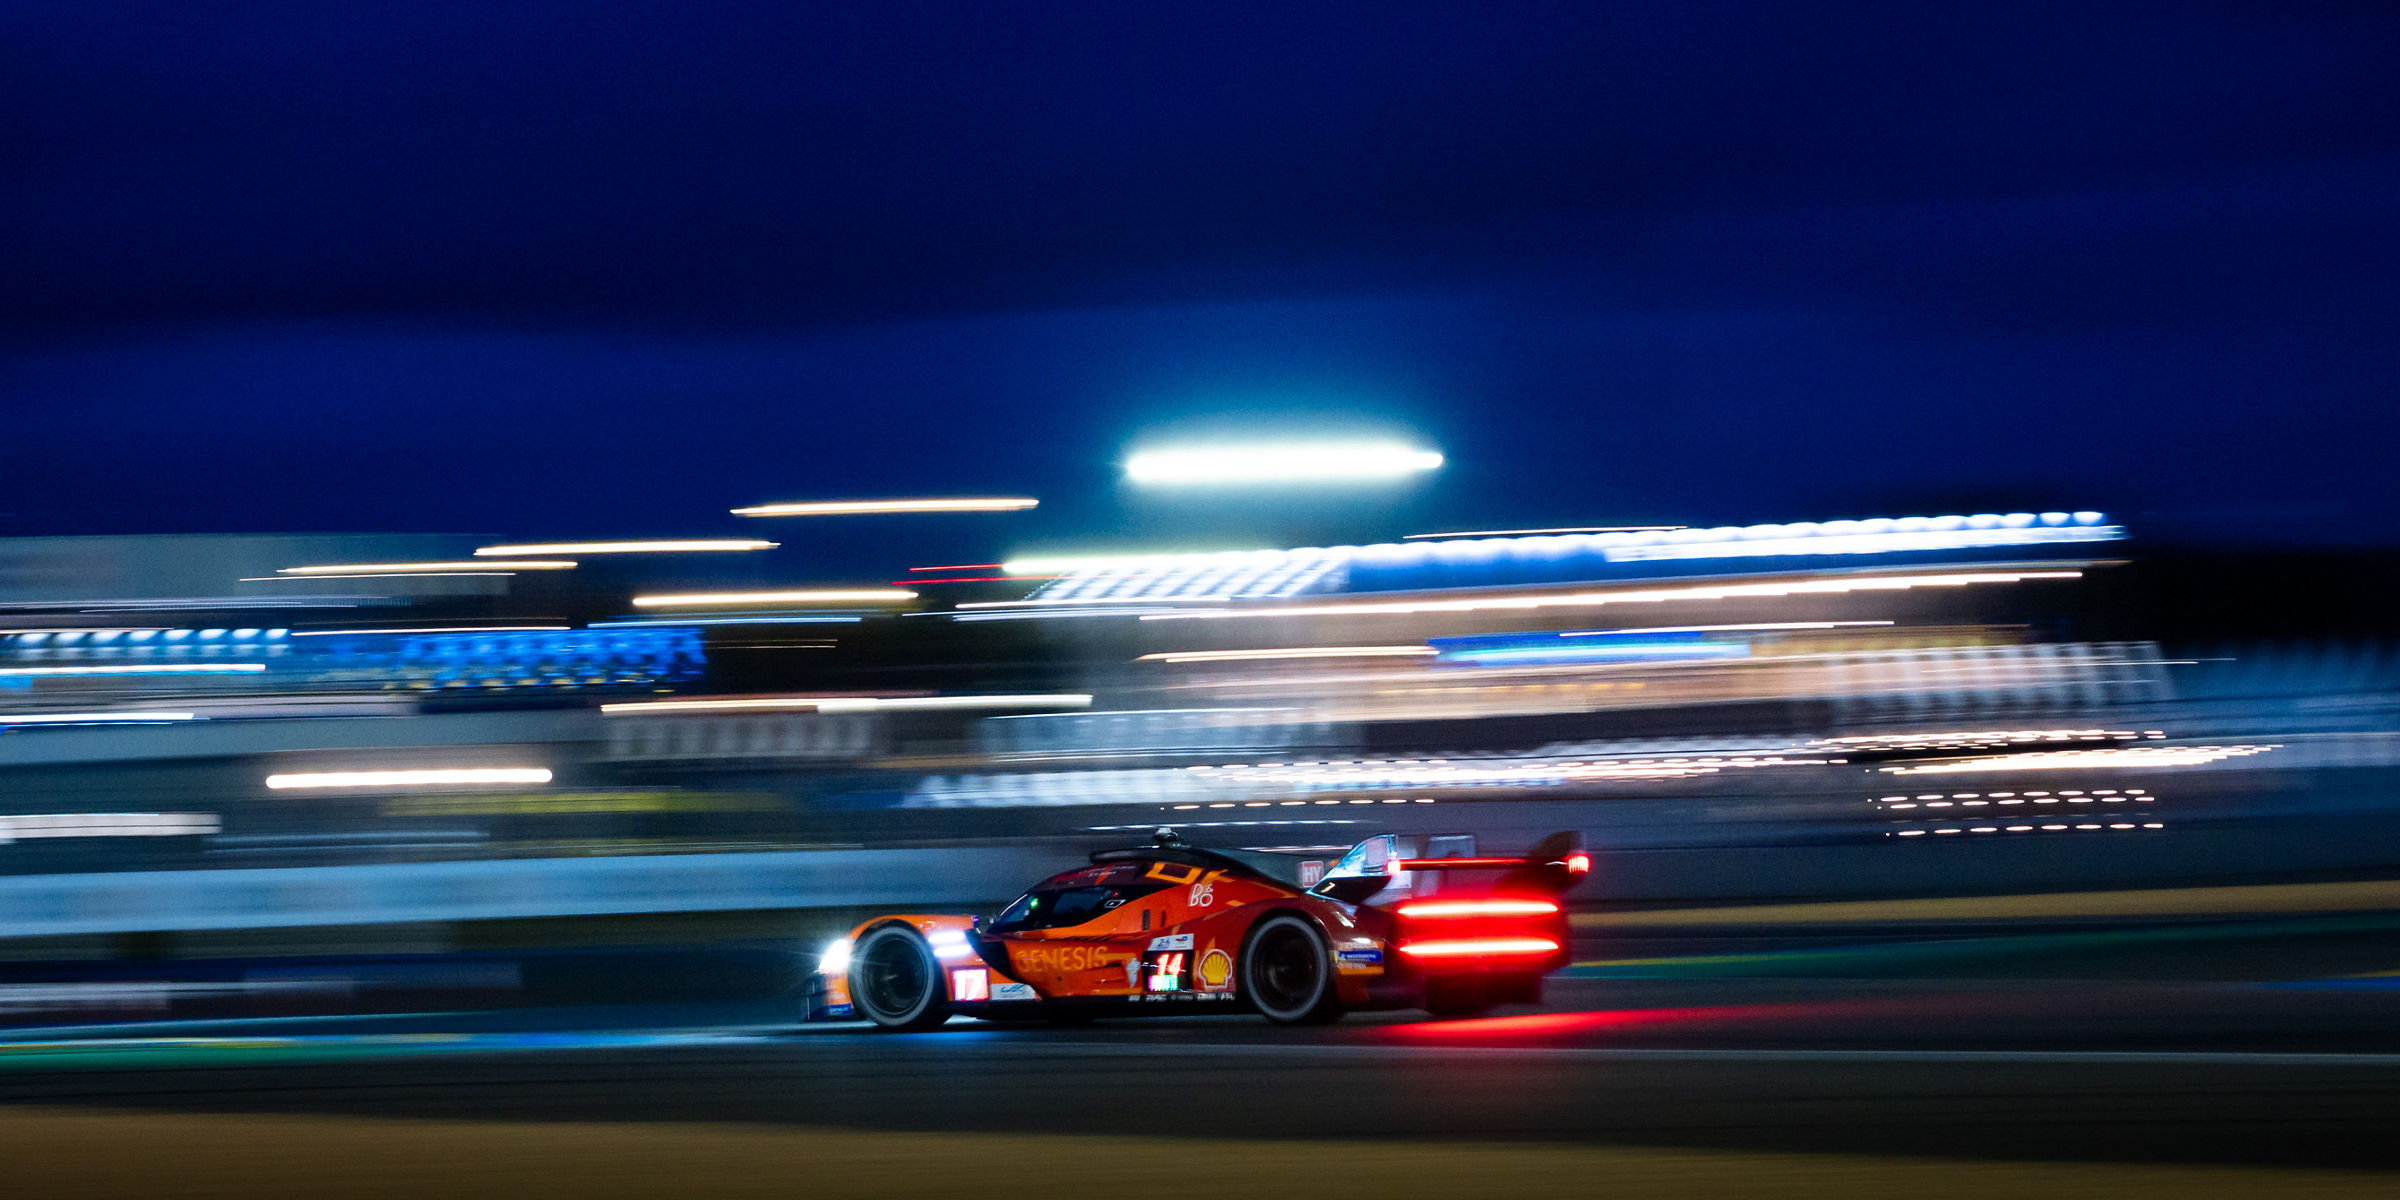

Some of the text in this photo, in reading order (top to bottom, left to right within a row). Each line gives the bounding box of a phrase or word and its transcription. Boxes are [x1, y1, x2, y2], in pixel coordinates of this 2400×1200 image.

[1303, 866, 1321, 885] HY
[1016, 946, 1108, 973] GENESIS
[1157, 952, 1184, 976] 14
[953, 969, 987, 1001] 17
